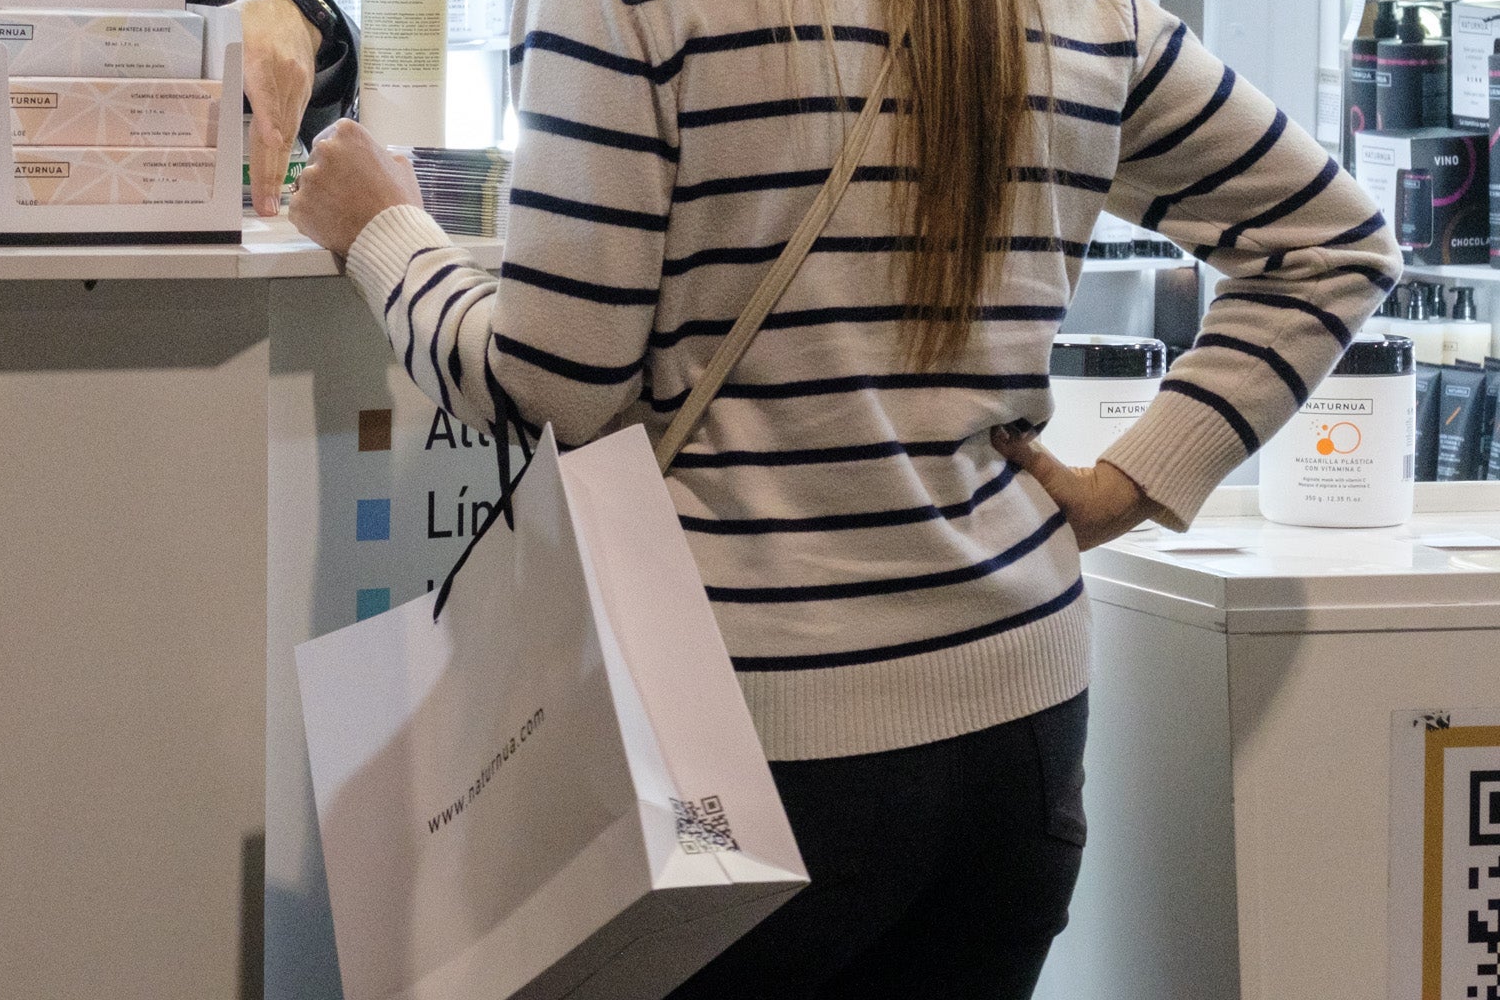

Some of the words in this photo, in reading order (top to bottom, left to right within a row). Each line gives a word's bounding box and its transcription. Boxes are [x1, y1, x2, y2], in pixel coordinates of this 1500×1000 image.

[1434, 156, 1459, 166] VINO
[15, 166, 63, 174] ATURNUA
[1305, 402, 1366, 411] NATURNUA
[1341, 456, 1374, 464] PLÁSTICA
[428, 706, 545, 834] www.naturnua.com
